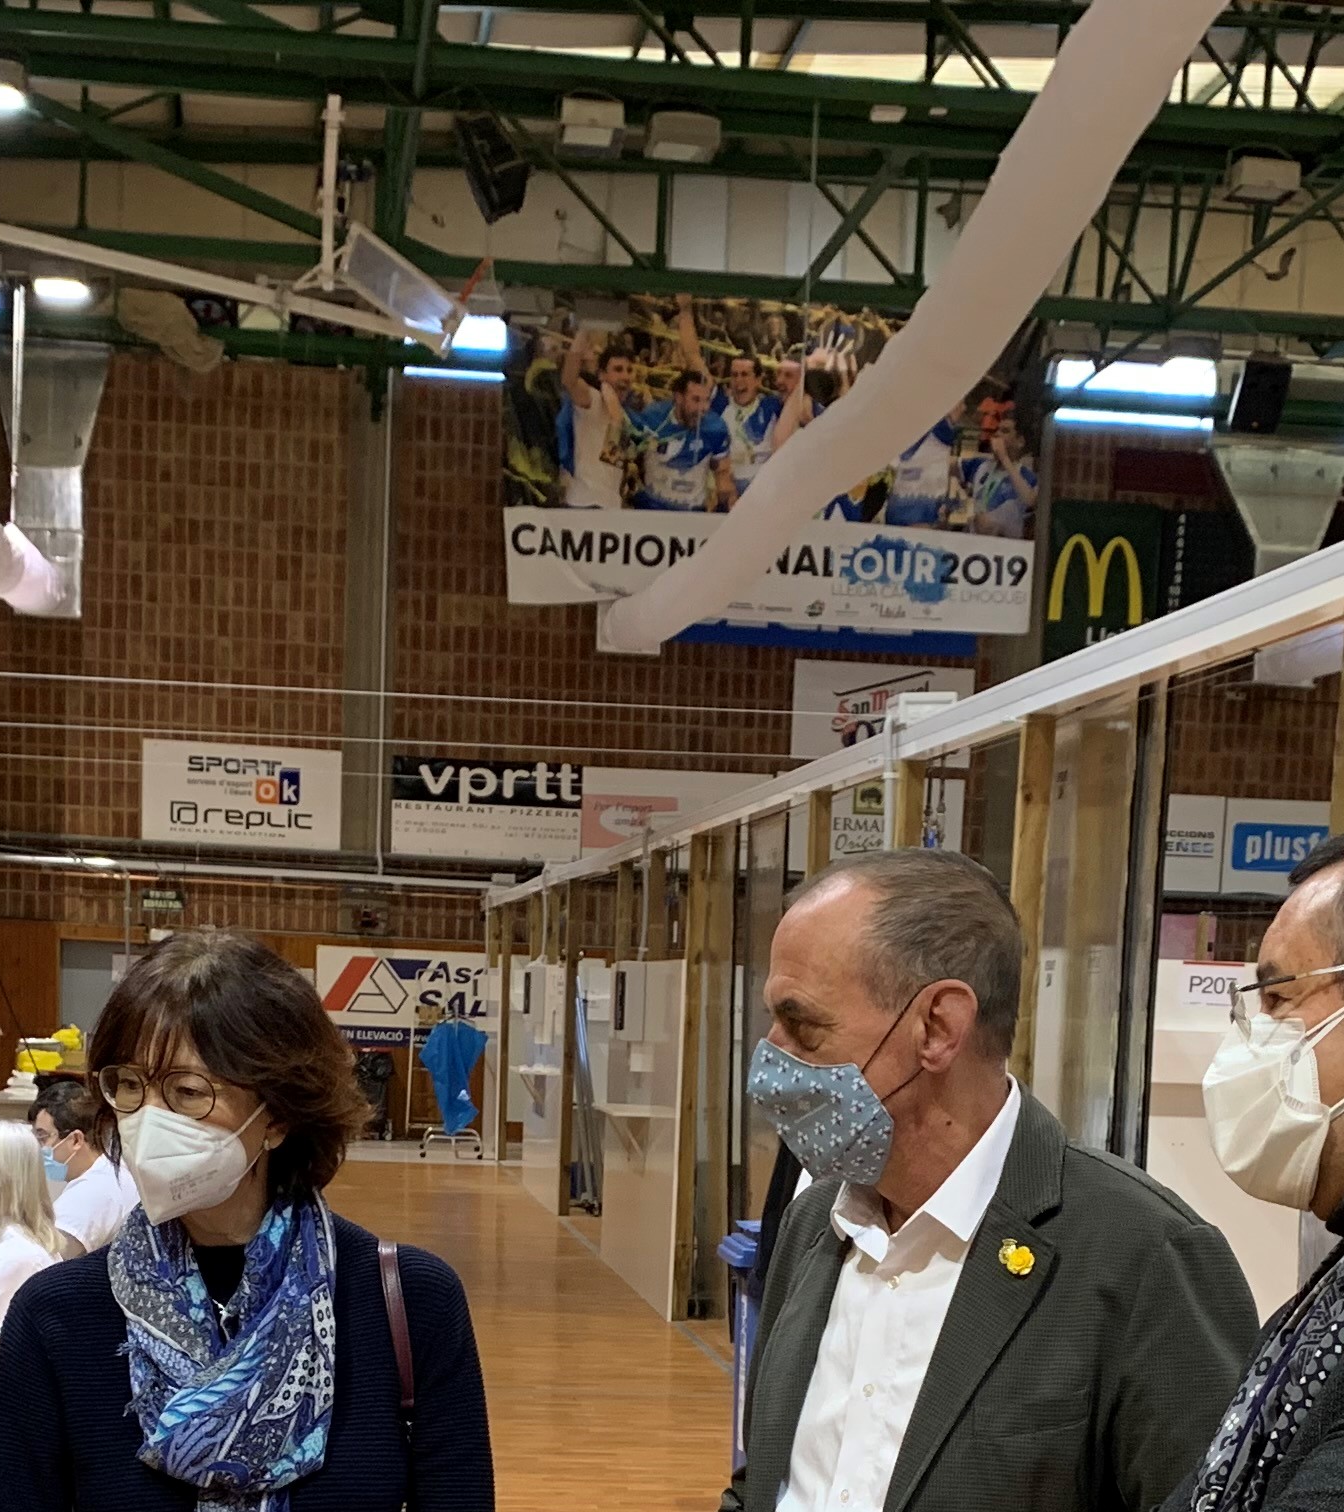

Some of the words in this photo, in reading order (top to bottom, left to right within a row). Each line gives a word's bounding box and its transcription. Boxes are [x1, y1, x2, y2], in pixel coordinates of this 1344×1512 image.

[418, 762, 582, 804] vprtt
[203, 809, 313, 830] replic
[394, 802, 495, 814] RESTAURANT
[510, 808, 580, 818] PIZZERIA
[833, 817, 884, 832] ERMA
[1165, 829, 1215, 839] CCIONS
[1244, 830, 1321, 864] plusf
[1188, 975, 1238, 995] P207
[415, 990, 487, 1017] SAL
[356, 1029, 404, 1043] ELEVACIÓ
